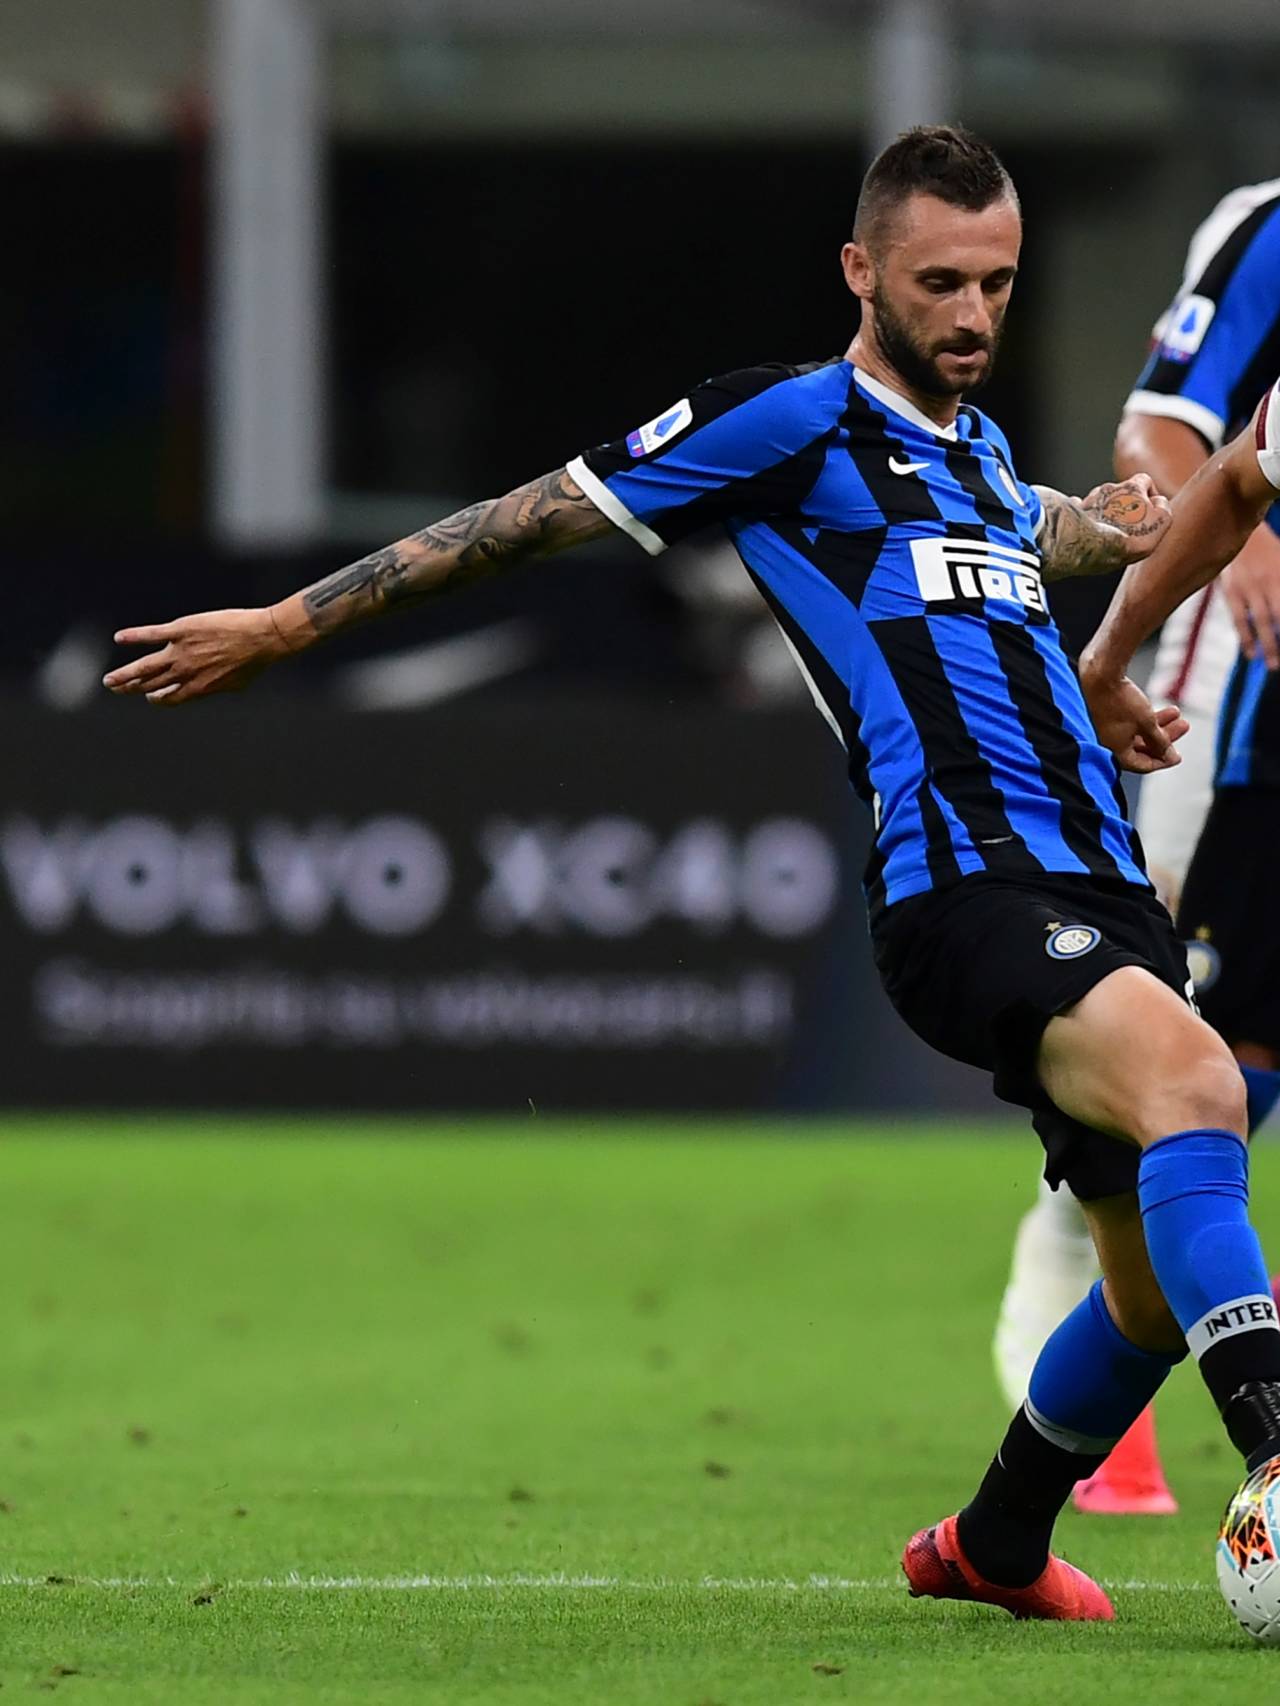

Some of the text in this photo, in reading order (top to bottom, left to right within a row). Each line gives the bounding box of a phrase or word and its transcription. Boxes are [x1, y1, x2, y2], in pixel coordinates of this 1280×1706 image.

[0, 814, 840, 938] VOLVO XC40
[1204, 1302, 1276, 1338] INTER
